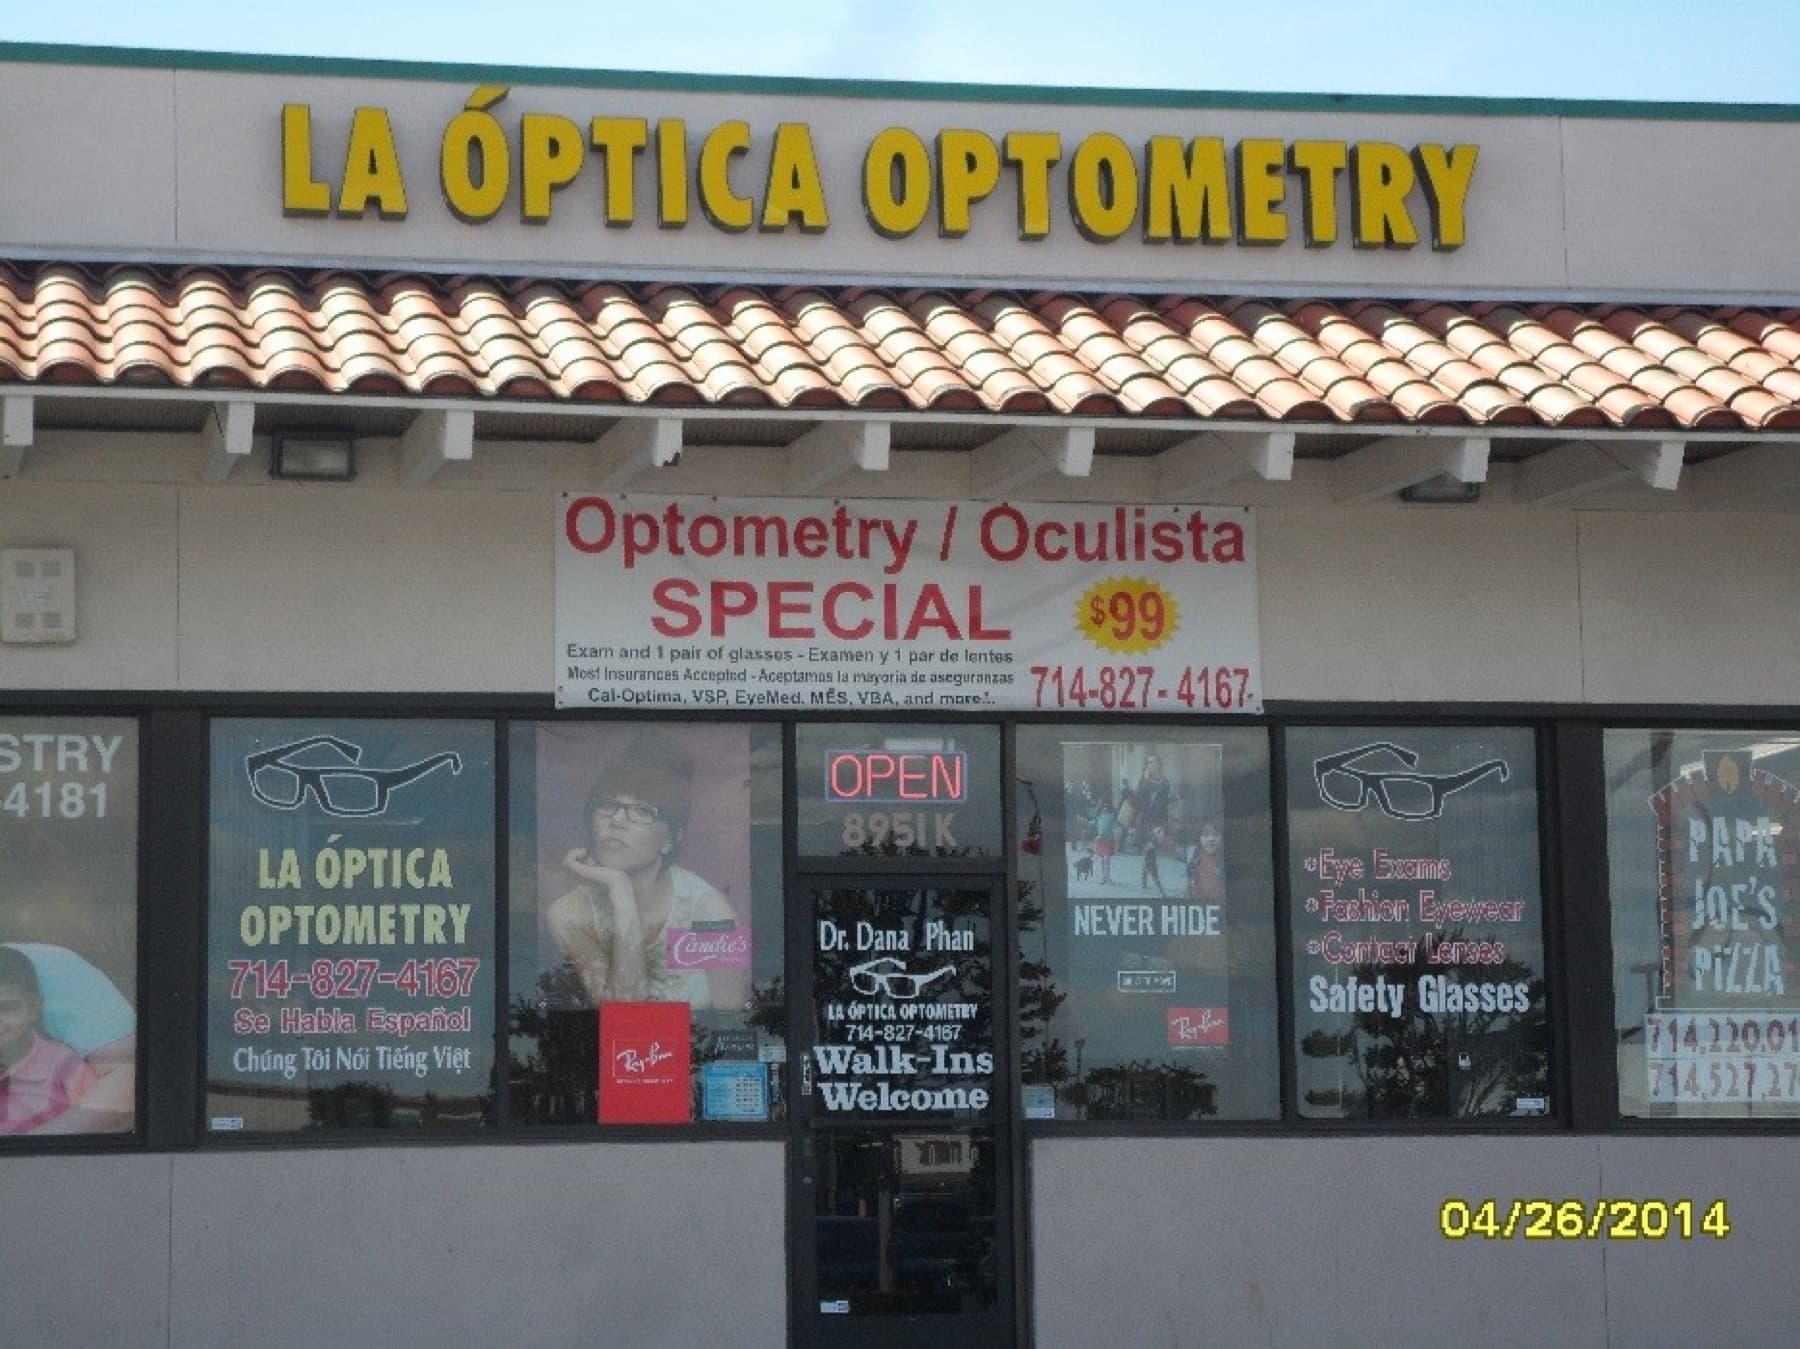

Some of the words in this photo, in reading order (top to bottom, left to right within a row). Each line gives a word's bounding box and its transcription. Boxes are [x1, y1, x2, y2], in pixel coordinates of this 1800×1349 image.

[282, 103, 408, 221] LA
[440, 84, 830, 234] ÓPTICA
[862, 127, 1481, 253] OPTOMETRY
[565, 497, 918, 575] Optometry
[939, 505, 958, 562] /
[980, 504, 1246, 564] Oculista
[651, 578, 1012, 641] SPECIAL
[1091, 591, 1165, 641] $99
[568, 643, 614, 658] Exam
[619, 645, 650, 659] and
[657, 645, 664, 659] 1
[670, 645, 701, 663] pair
[707, 645, 724, 660] of
[729, 646, 793, 663] glasses
[809, 647, 874, 662] Examen
[880, 650, 889, 665] y
[896, 649, 901, 662] 1
[909, 650, 933, 666] par
[940, 648, 959, 662] de
[965, 648, 1014, 663] lentes
[568, 666, 600, 680] Most
[604, 667, 679, 681] Insurances
[684, 668, 747, 684] Accepted
[759, 668, 833, 685] Aceptamos
[838, 670, 849, 683] la
[911, 670, 926, 683] de
[930, 672, 1014, 687] aseguranzas
[588, 687, 687, 705] Cal-Optima,
[692, 689, 730, 705] VSP,
[903, 692, 934, 705] and
[831, 753, 962, 799] OPEN
[3, 782, 107, 818] 4181
[1689, 816, 1778, 868] PAPA
[259, 848, 302, 889] LA
[315, 834, 454, 889] ÓPTICA
[1319, 848, 1364, 887] Eye
[1373, 848, 1452, 881] Exams
[1075, 904, 1155, 936] NEVER
[1161, 904, 1221, 936] HIDE
[1320, 888, 1409, 922] Fashion
[1419, 890, 1526, 930] Eyewear
[1691, 876, 1778, 932] JOE'S
[240, 904, 471, 947] OPTOMETRY
[820, 920, 849, 951] Dr.
[857, 921, 909, 951] Dana
[926, 921, 975, 951] Phan
[1322, 930, 1417, 965] Contact
[1426, 933, 1505, 965] Lenses
[228, 958, 480, 999] 714-827-4167
[1309, 974, 1406, 1019] Safety
[1417, 974, 1531, 1014] Glasses
[234, 1008, 271, 1036] Se
[281, 1007, 357, 1034] Habla
[367, 1005, 471, 1038] Español
[828, 1003, 845, 1021] LA
[848, 1000, 897, 1021] ÓPTICA
[900, 1003, 978, 1021] OPTOMETRY
[845, 1024, 962, 1041] 714-827-4167
[233, 1047, 298, 1080] Chúng
[336, 1047, 370, 1072] Nói
[813, 1045, 994, 1075] Walk-Ins
[816, 1082, 990, 1111] Welcome
